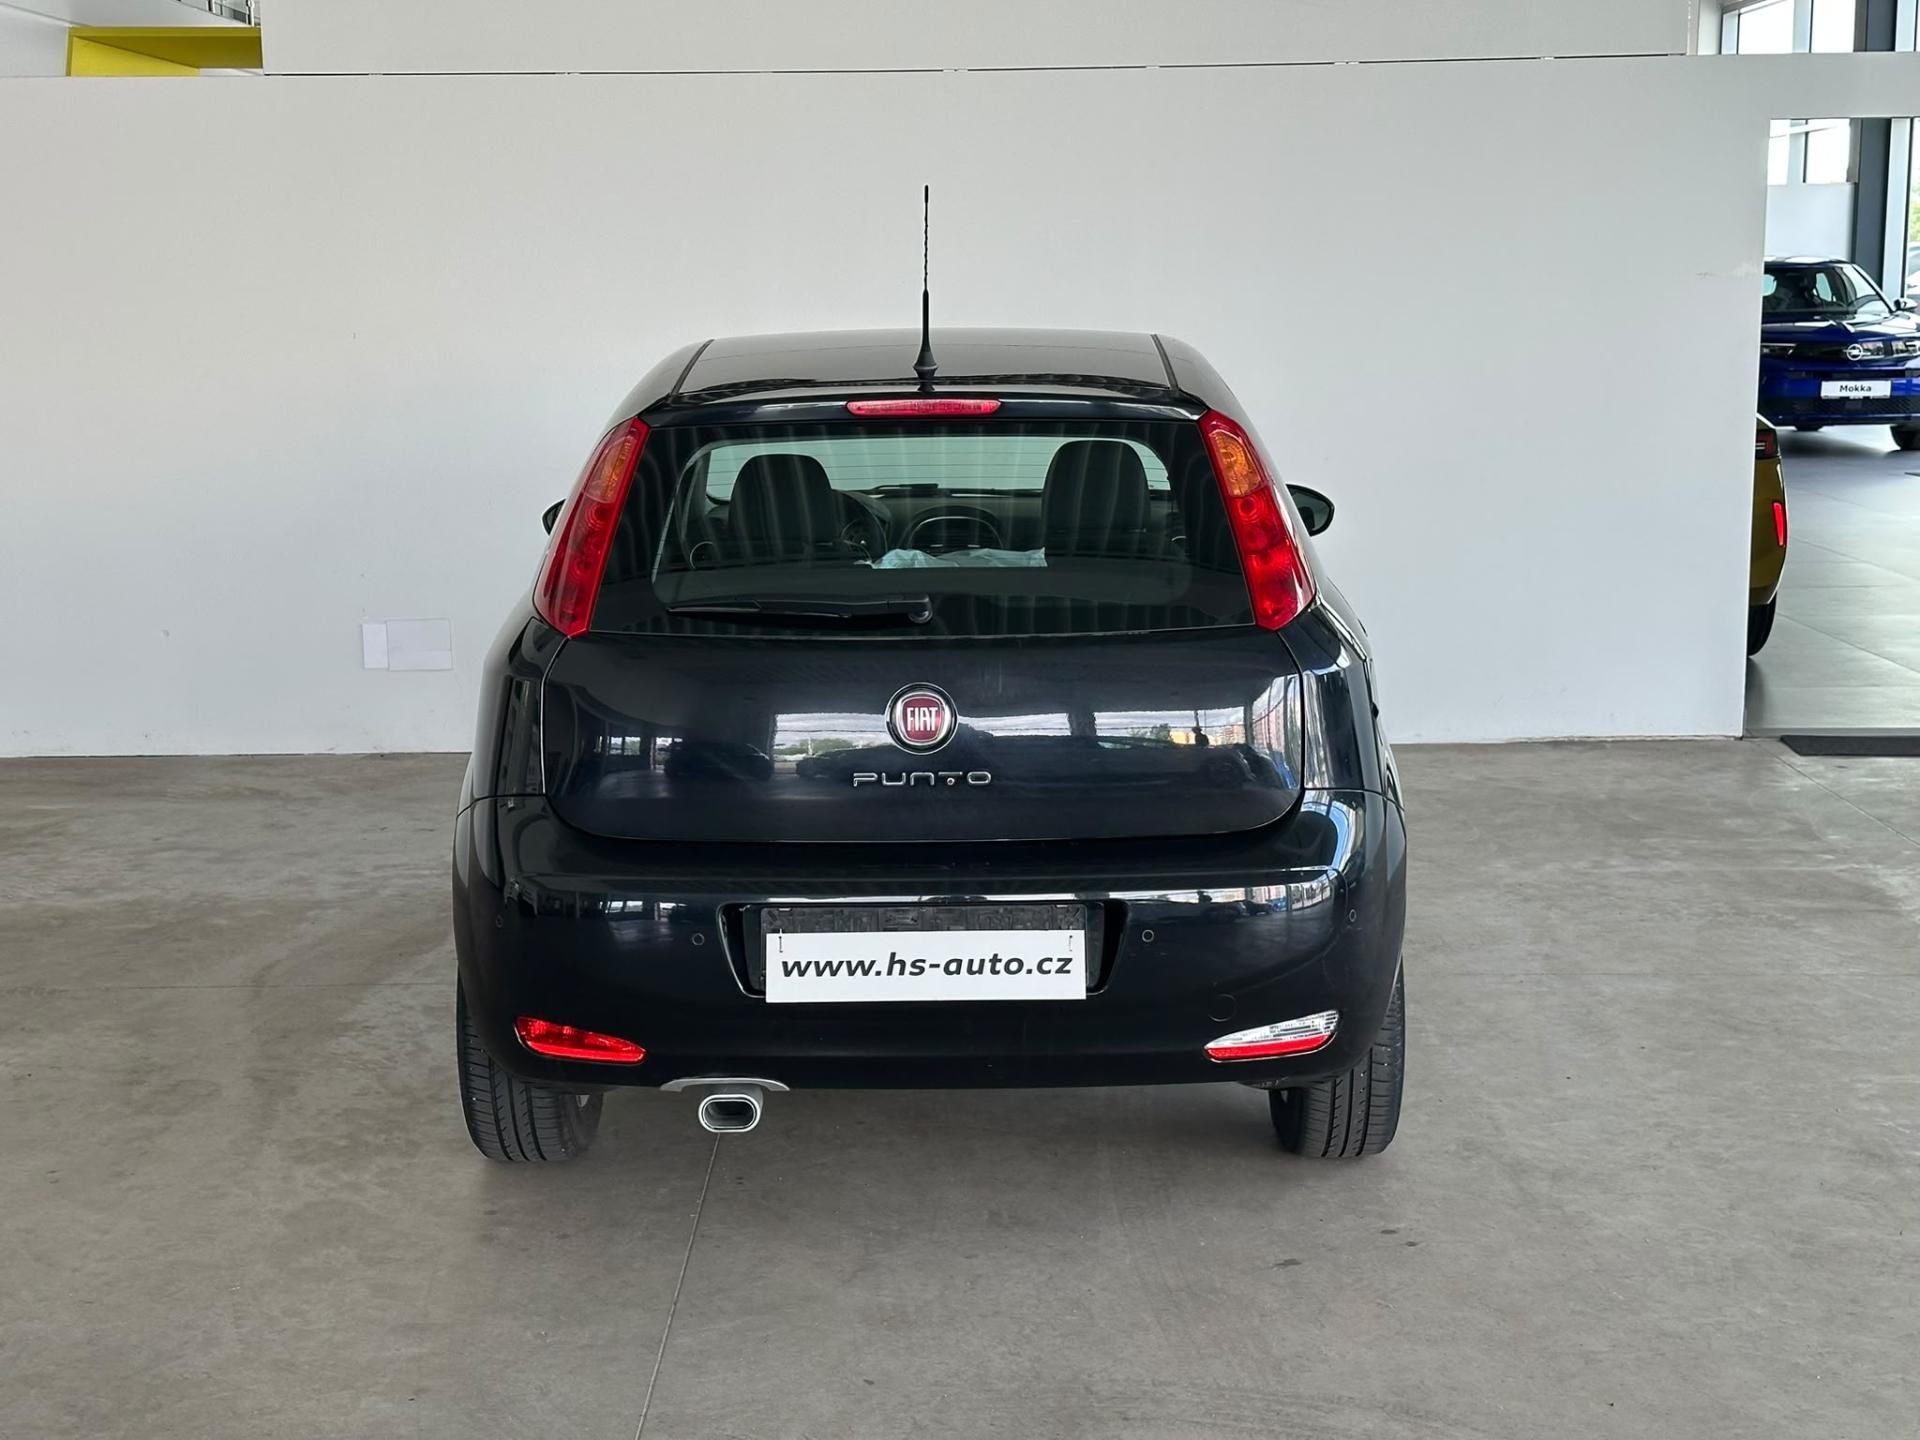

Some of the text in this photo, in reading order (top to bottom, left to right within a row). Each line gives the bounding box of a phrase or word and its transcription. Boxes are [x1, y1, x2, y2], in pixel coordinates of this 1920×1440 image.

[1839, 384, 1872, 393] Mokka
[906, 706, 939, 732] FIAT
[853, 771, 992, 787] PUNTO
[781, 952, 1073, 978] www.hs-auto.cz
